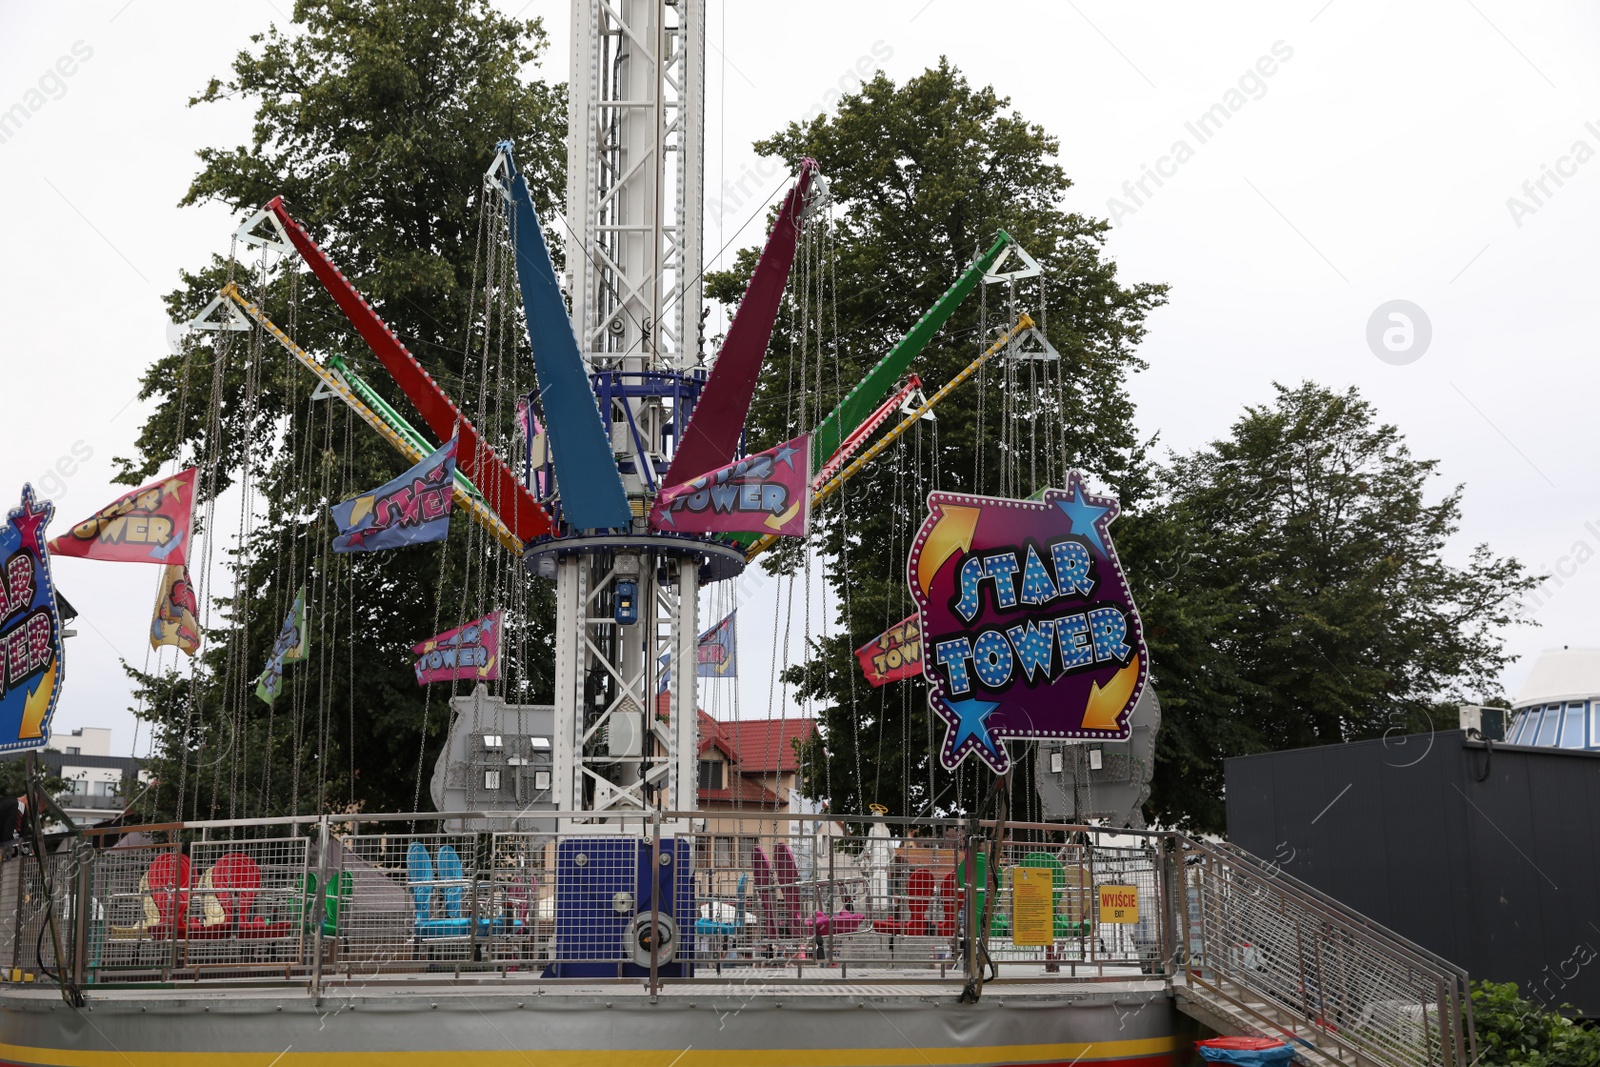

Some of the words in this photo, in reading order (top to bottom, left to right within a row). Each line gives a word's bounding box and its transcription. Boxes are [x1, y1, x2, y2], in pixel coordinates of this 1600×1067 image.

[955, 541, 1095, 622] STAR
[420, 646, 487, 670] TOWER
[936, 607, 1132, 696] TOWER
[1102, 891, 1136, 908] WYJŚCIE
[1114, 909, 1125, 918] EXIT
